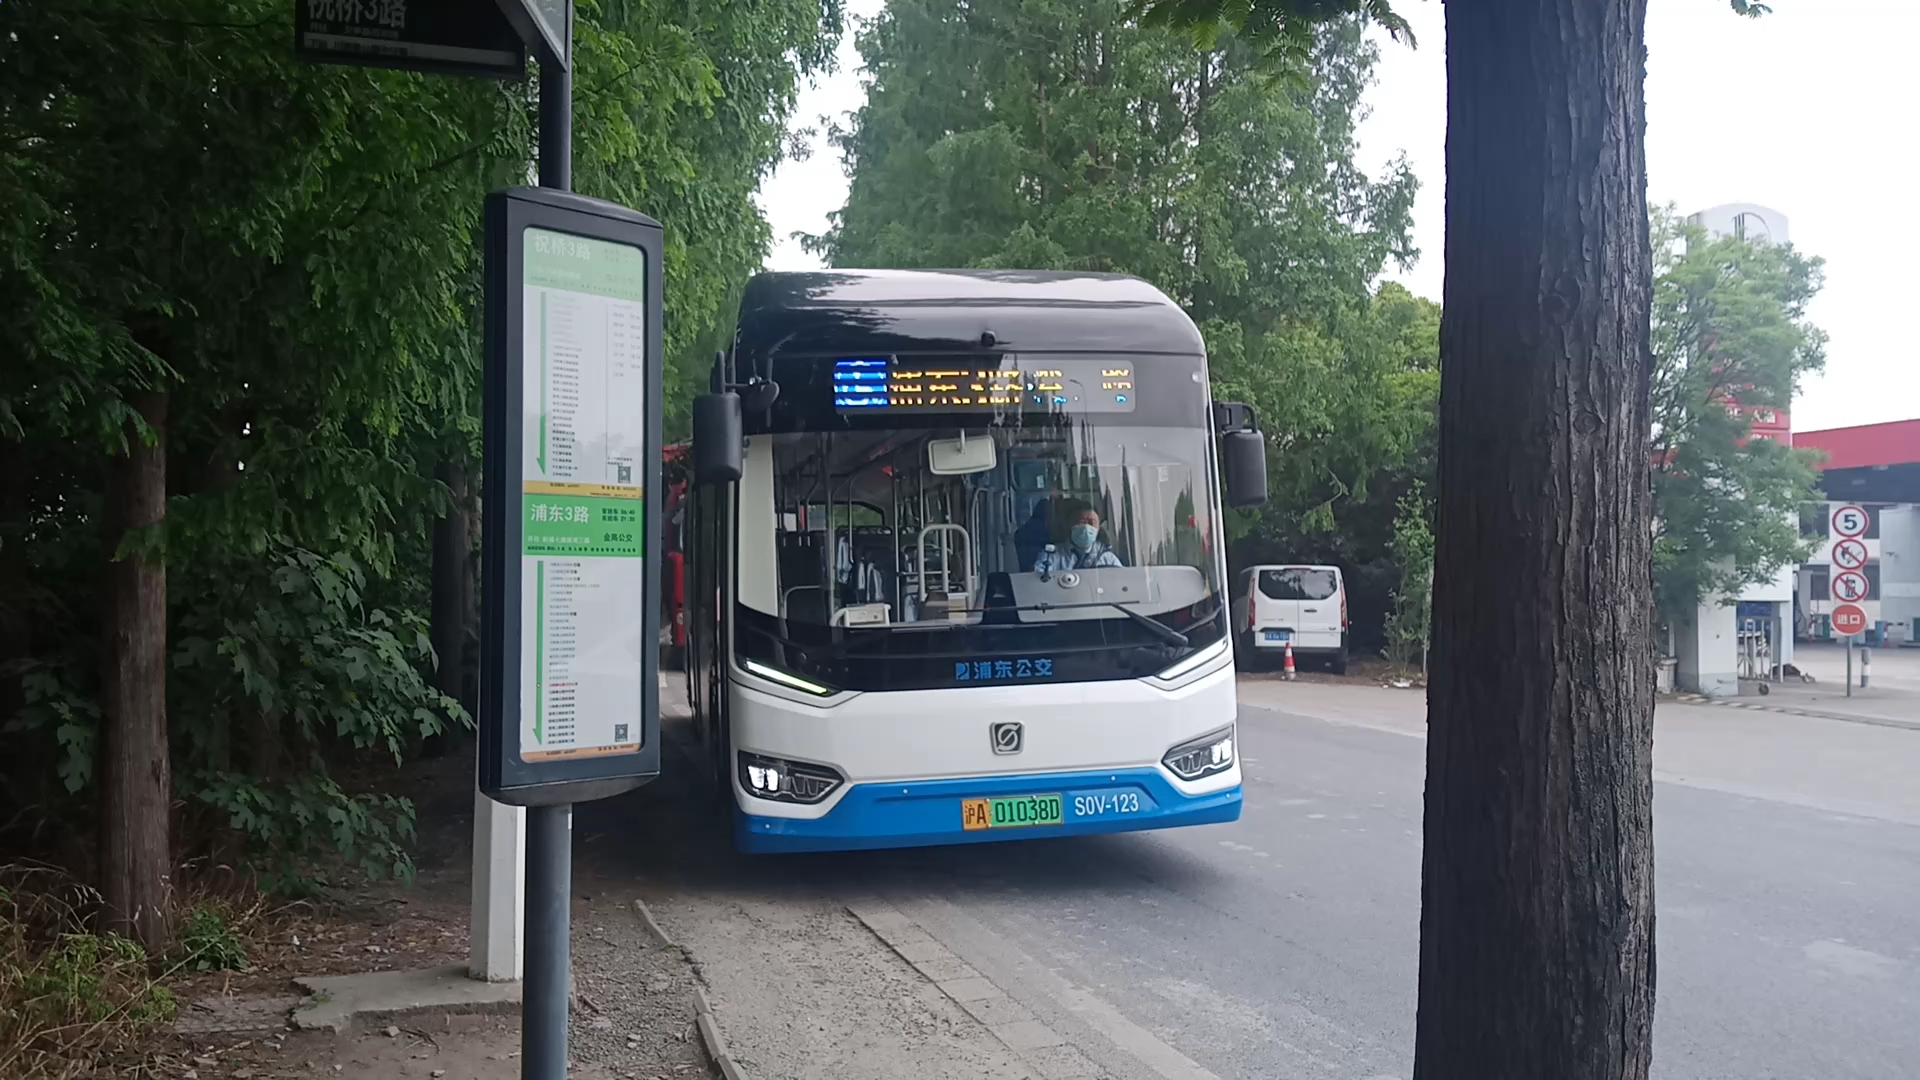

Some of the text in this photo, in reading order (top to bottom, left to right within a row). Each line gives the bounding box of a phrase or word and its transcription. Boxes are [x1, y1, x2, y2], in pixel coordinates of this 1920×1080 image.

[531, 503, 589, 524] 浦东3路
[1844, 514, 1857, 530] 5
[973, 658, 1053, 680] 浦东公交
